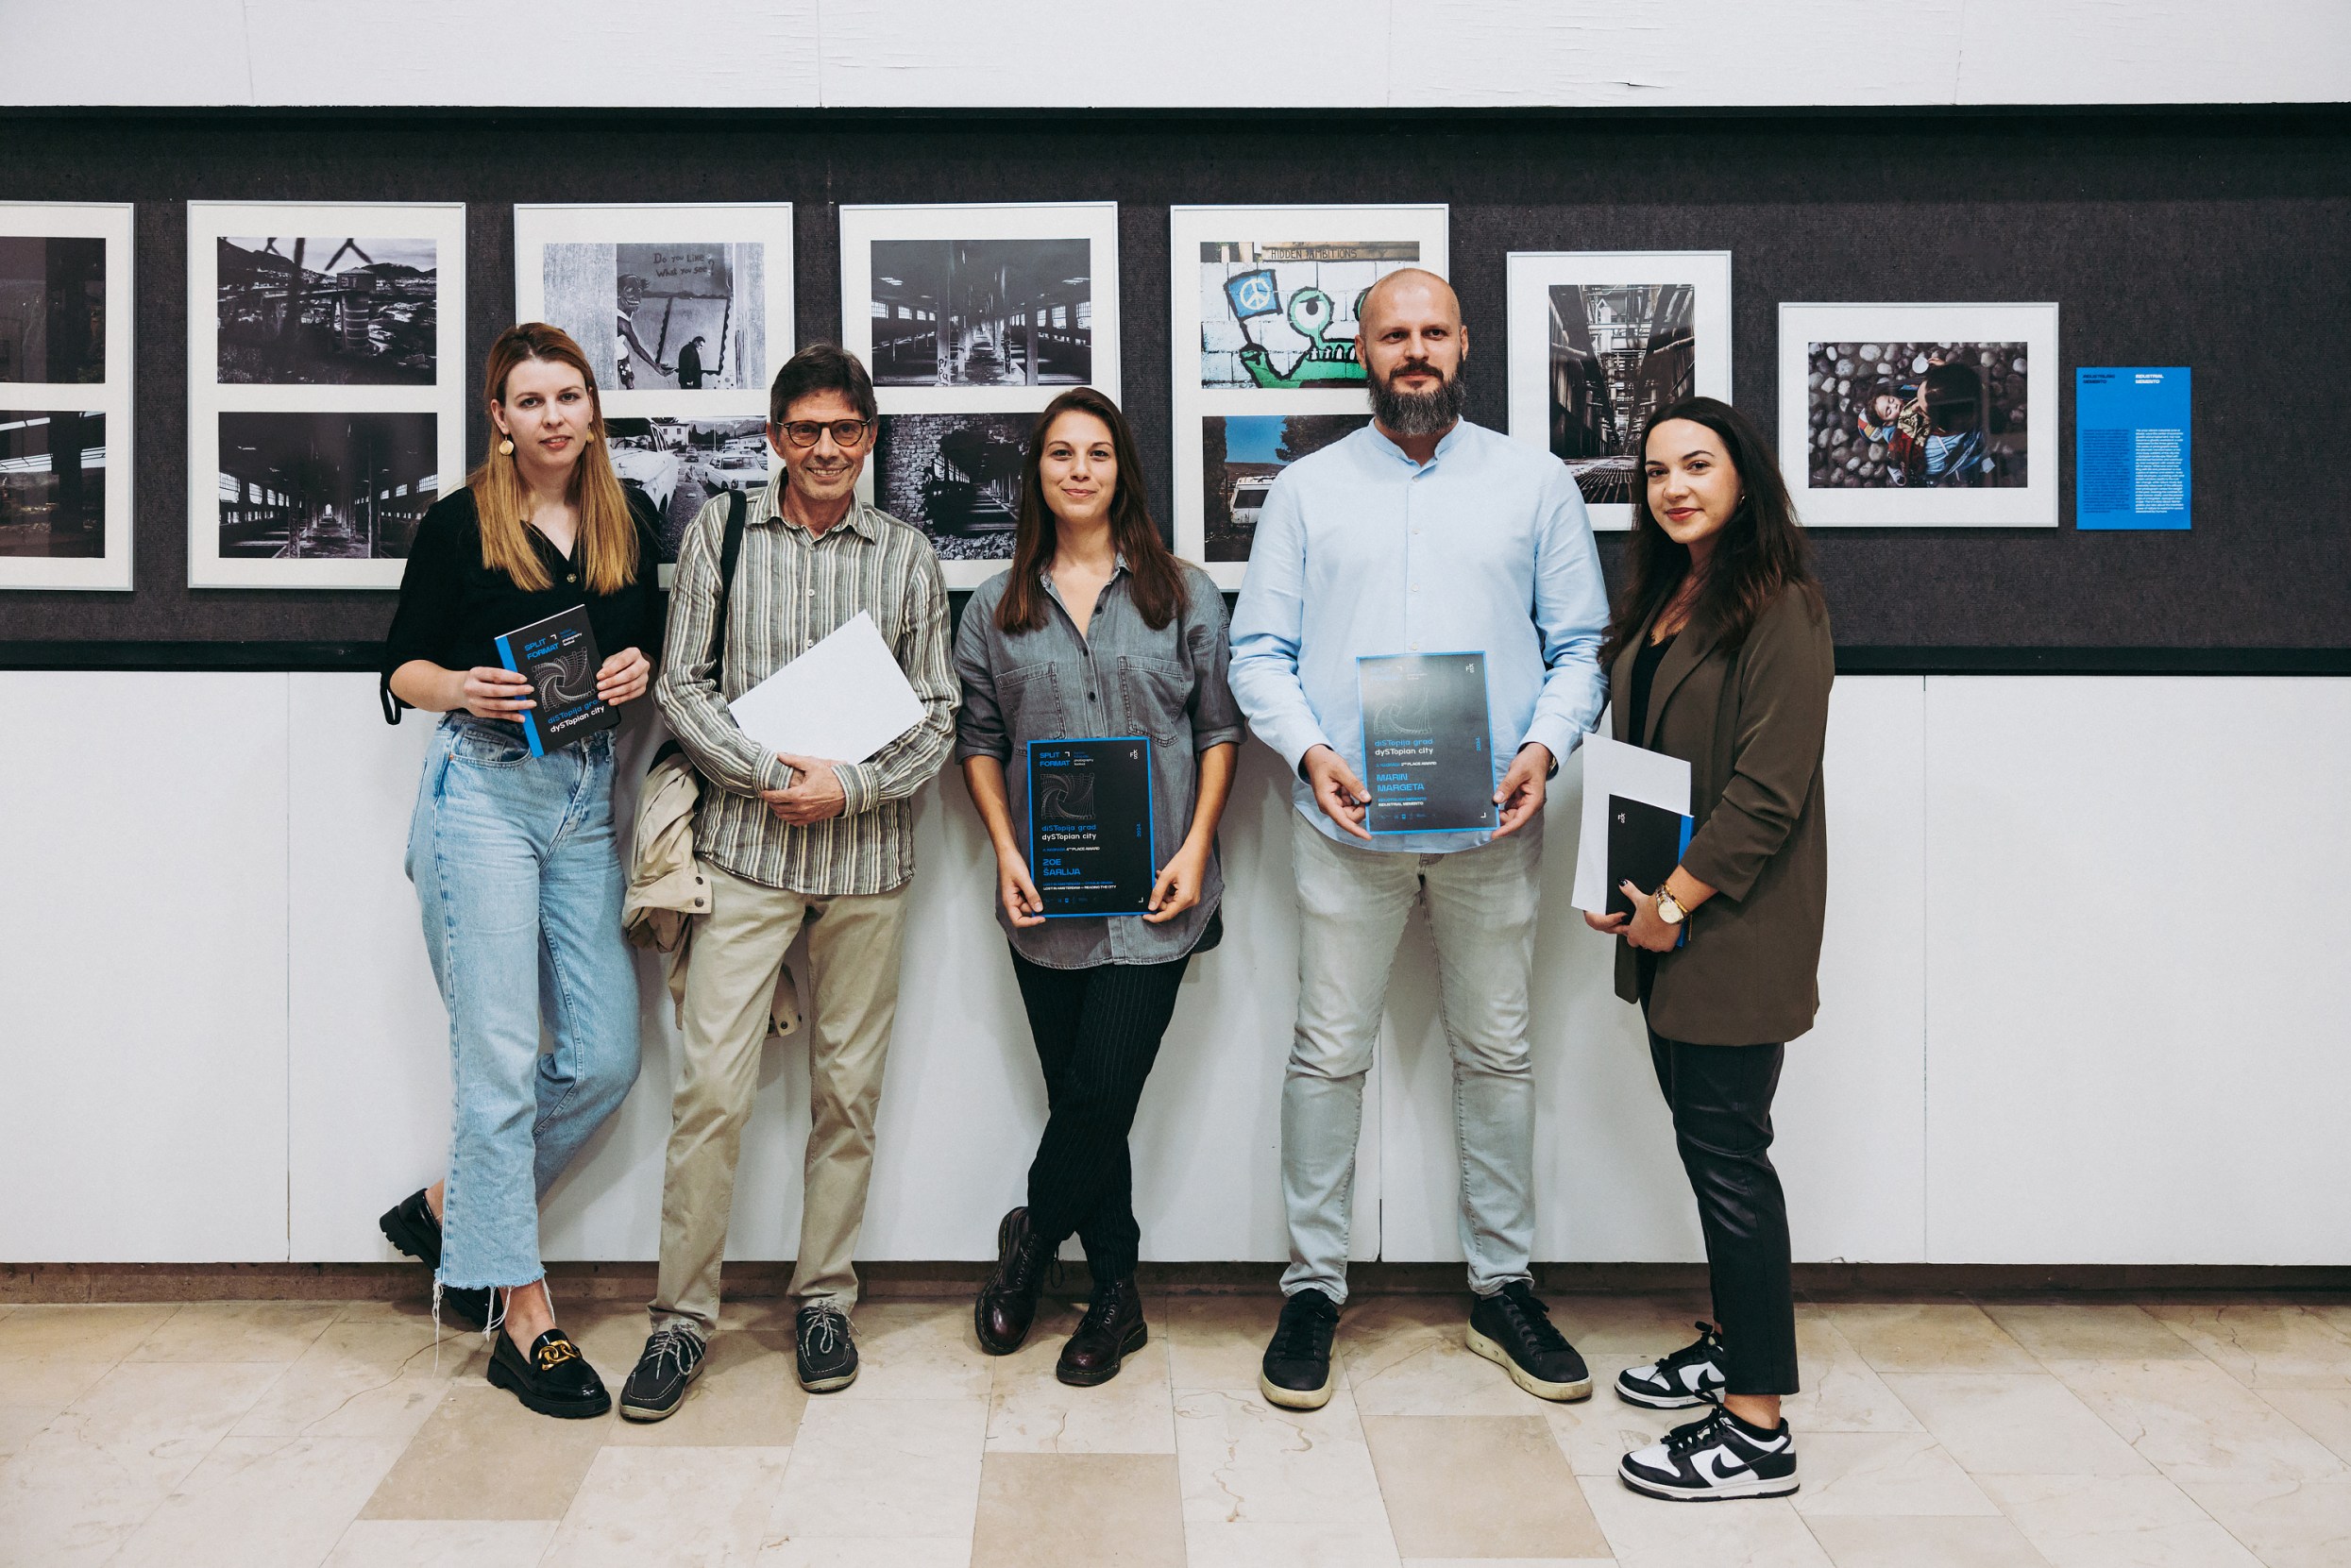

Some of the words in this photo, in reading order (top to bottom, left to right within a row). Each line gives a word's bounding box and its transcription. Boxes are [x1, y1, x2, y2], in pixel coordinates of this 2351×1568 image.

[653, 252, 668, 264] Do
[1271, 248, 1302, 260] HIDDEN
[524, 637, 547, 651] SPLIT
[527, 642, 559, 660] FORMAT
[590, 705, 604, 716] city
[1413, 738, 1433, 747] grad
[1377, 773, 1408, 782] MARIN
[1377, 784, 1425, 792] MARGETA
[1078, 824, 1096, 833] grad
[1082, 833, 1097, 841] city
[1042, 858, 1061, 867] ZOE
[1042, 867, 1081, 876] ŠARLIJA
